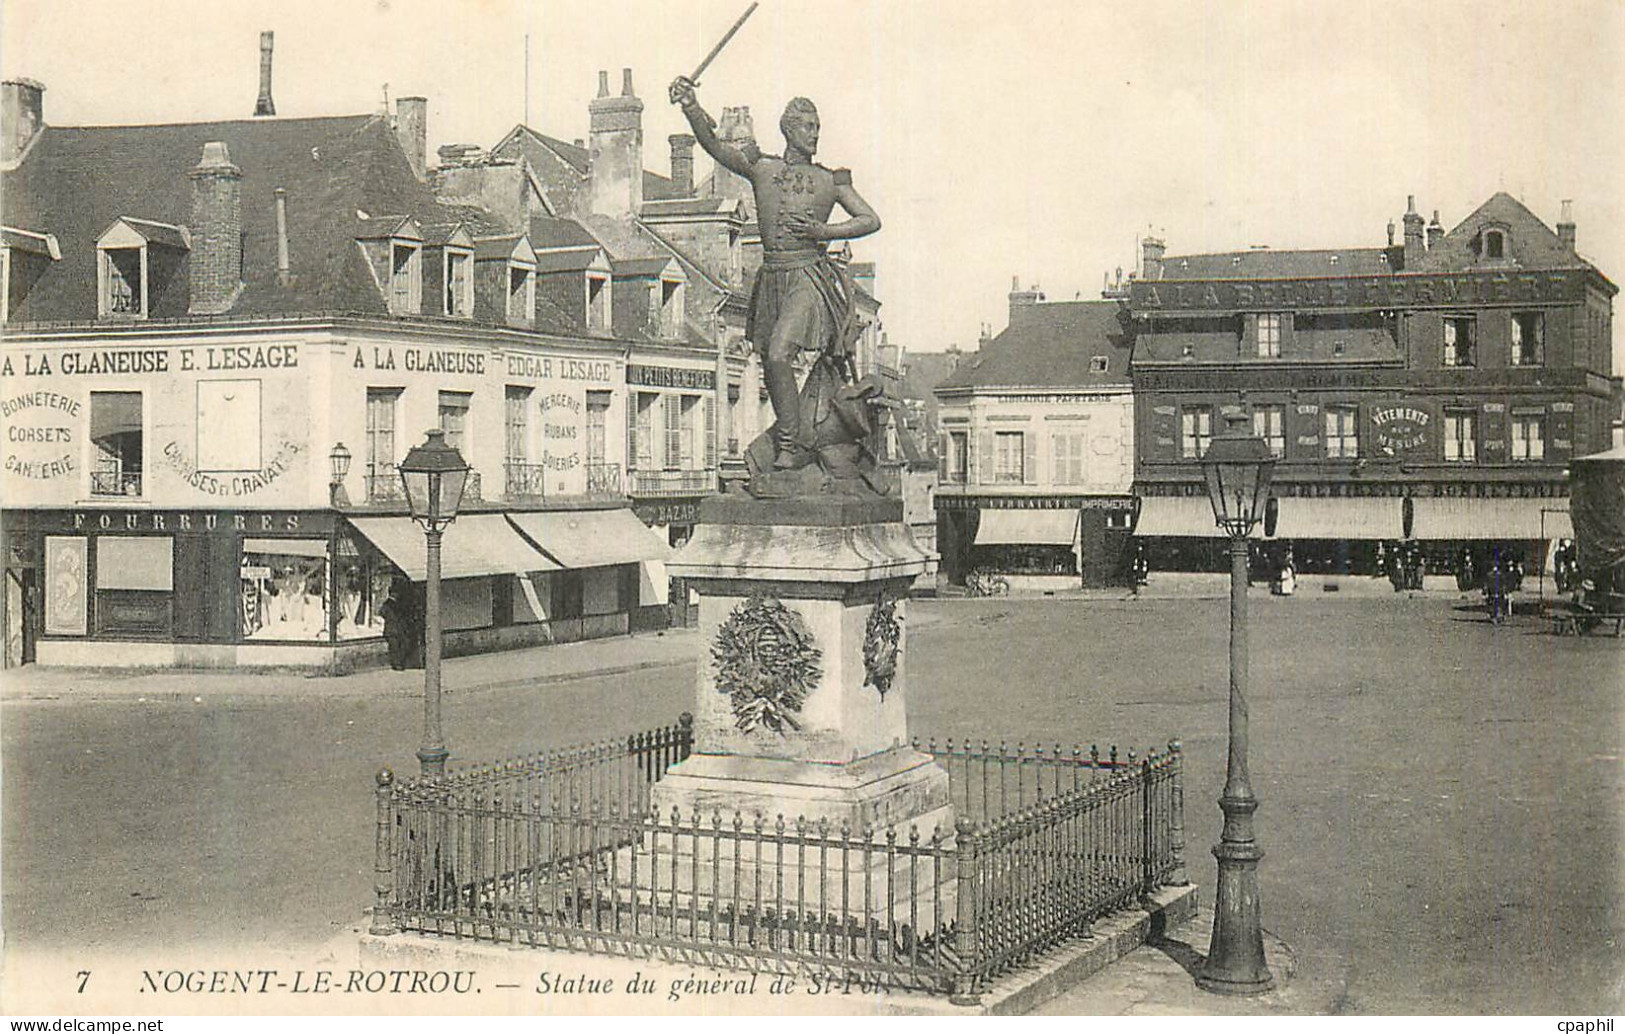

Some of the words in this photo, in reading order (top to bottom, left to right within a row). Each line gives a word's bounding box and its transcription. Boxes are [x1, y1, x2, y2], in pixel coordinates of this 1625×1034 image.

[2, 353, 15, 376] A
[25, 352, 51, 376] LA
[61, 350, 169, 375] GLANEUSE
[180, 349, 200, 371] E.
[207, 345, 299, 370] LESAGE
[353, 346, 364, 369] A
[374, 347, 395, 370] LA
[405, 349, 485, 374] GLANEUSE
[507, 355, 552, 379] EDGAR
[560, 359, 611, 382] LESAGE
[644, 367, 671, 387] PETITS
[1, 391, 82, 418] BONNETERIE
[539, 393, 581, 415] MERCERIE
[9, 425, 72, 443] CORSETS
[544, 423, 577, 439] RUBANS
[1376, 433, 1427, 449] MESURE
[5, 454, 75, 479] GANERIE
[232, 440, 300, 496] CRAVATS
[542, 449, 580, 471] SOIERIES
[658, 504, 695, 521] BAZAR
[989, 499, 1071, 509] LIBRAIRIE
[74, 514, 300, 530] FOURRURES
